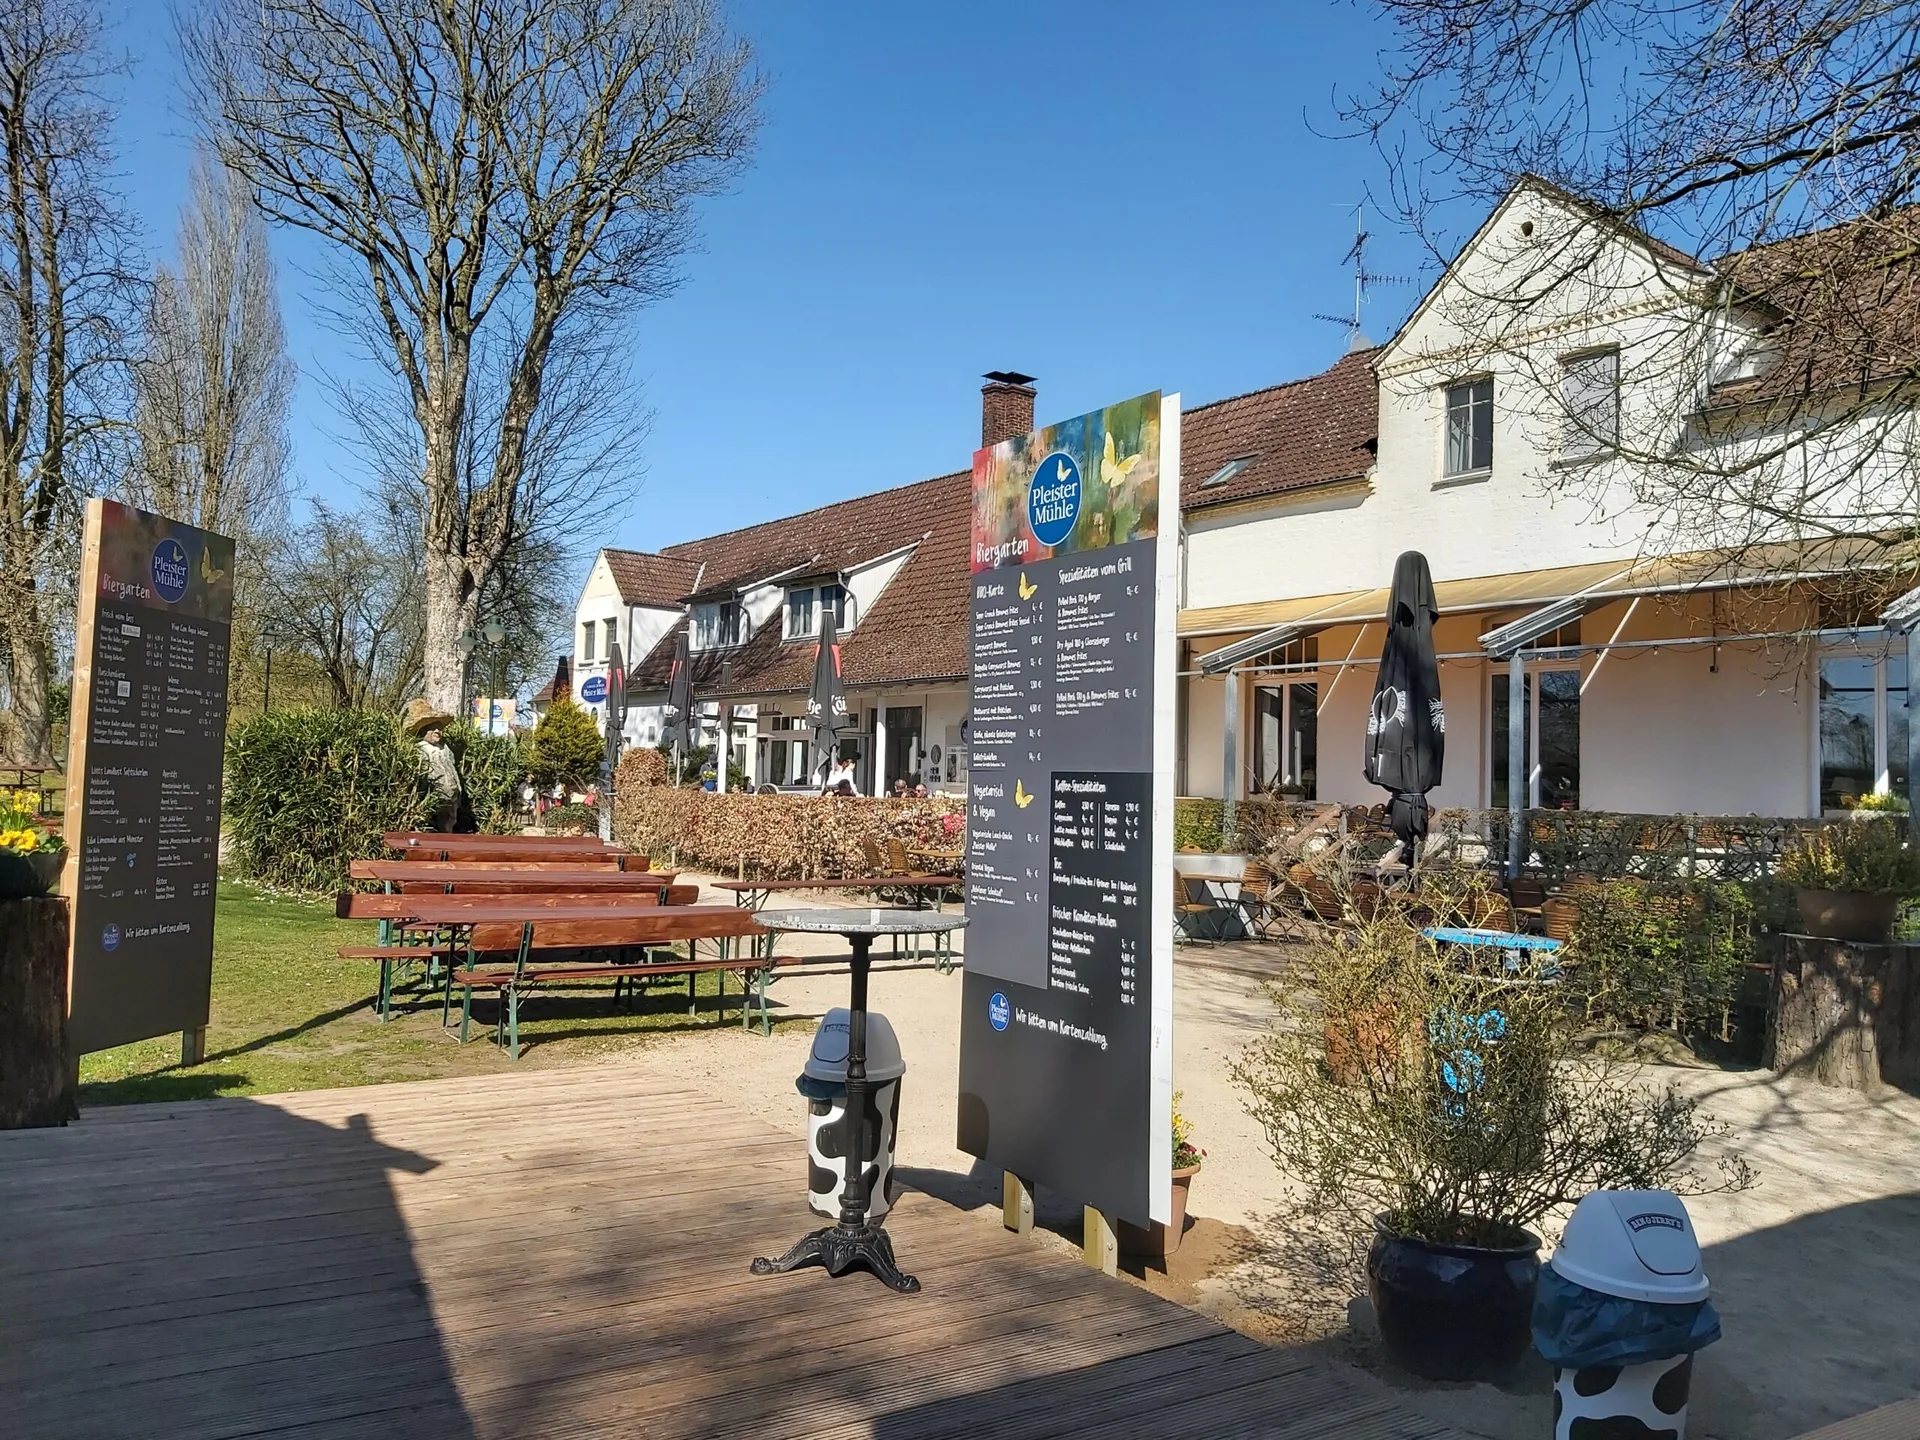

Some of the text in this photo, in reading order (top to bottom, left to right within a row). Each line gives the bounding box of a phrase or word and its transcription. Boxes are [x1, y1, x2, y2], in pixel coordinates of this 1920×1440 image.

[1032, 482, 1077, 507] Pleister
[1035, 500, 1074, 525] Mühle
[976, 536, 1029, 566] Biergarten
[154, 556, 186, 576] Pleister
[1059, 557, 1131, 585] Spezialitäten vom Grill
[103, 574, 150, 599] Biergarten
[155, 572, 183, 589] Mühle
[973, 784, 1004, 800] Vegetarisch
[973, 805, 995, 821] & Vegan
[1054, 857, 1062, 869] Tee
[1053, 905, 1072, 920] Frischer
[126, 928, 134, 938] Wir
[991, 1004, 1008, 1014] Pleister
[1016, 1007, 1108, 1050] Wir bitten um Kartenzahlung.
[1630, 1218, 1646, 1229] BEN
